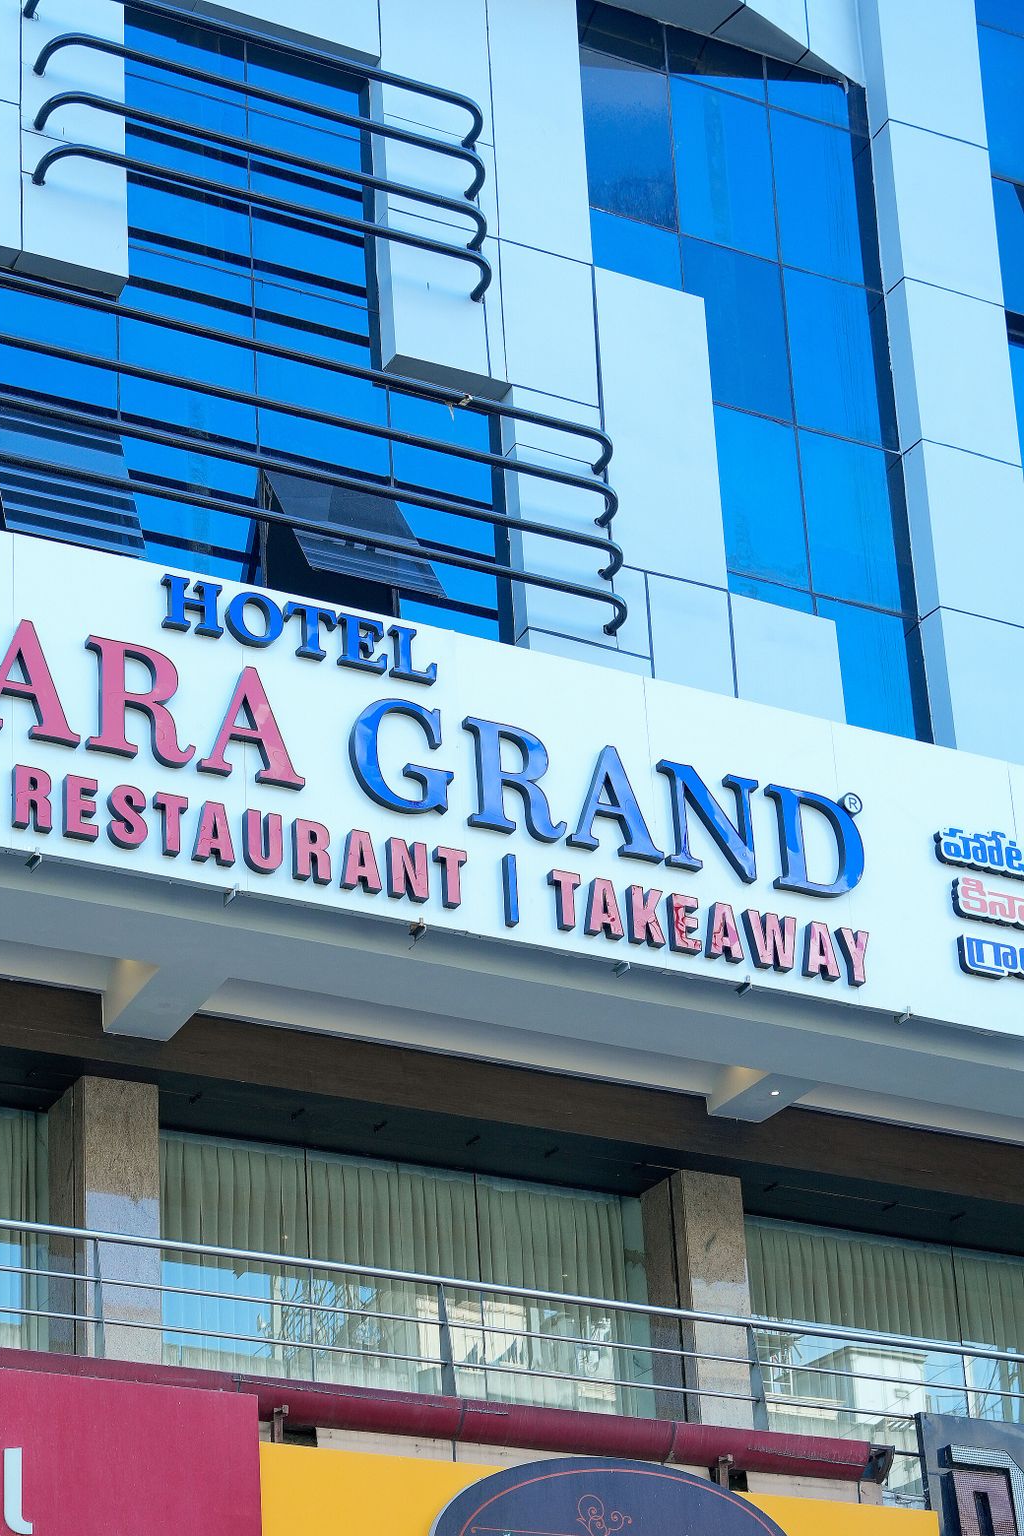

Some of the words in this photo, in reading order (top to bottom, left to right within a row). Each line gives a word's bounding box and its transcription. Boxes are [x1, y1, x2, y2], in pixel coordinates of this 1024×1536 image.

[161, 574, 438, 686] HOTEL
[12, 764, 467, 908] RESTAURANT
[548, 869, 870, 987] TAKEAWAY
